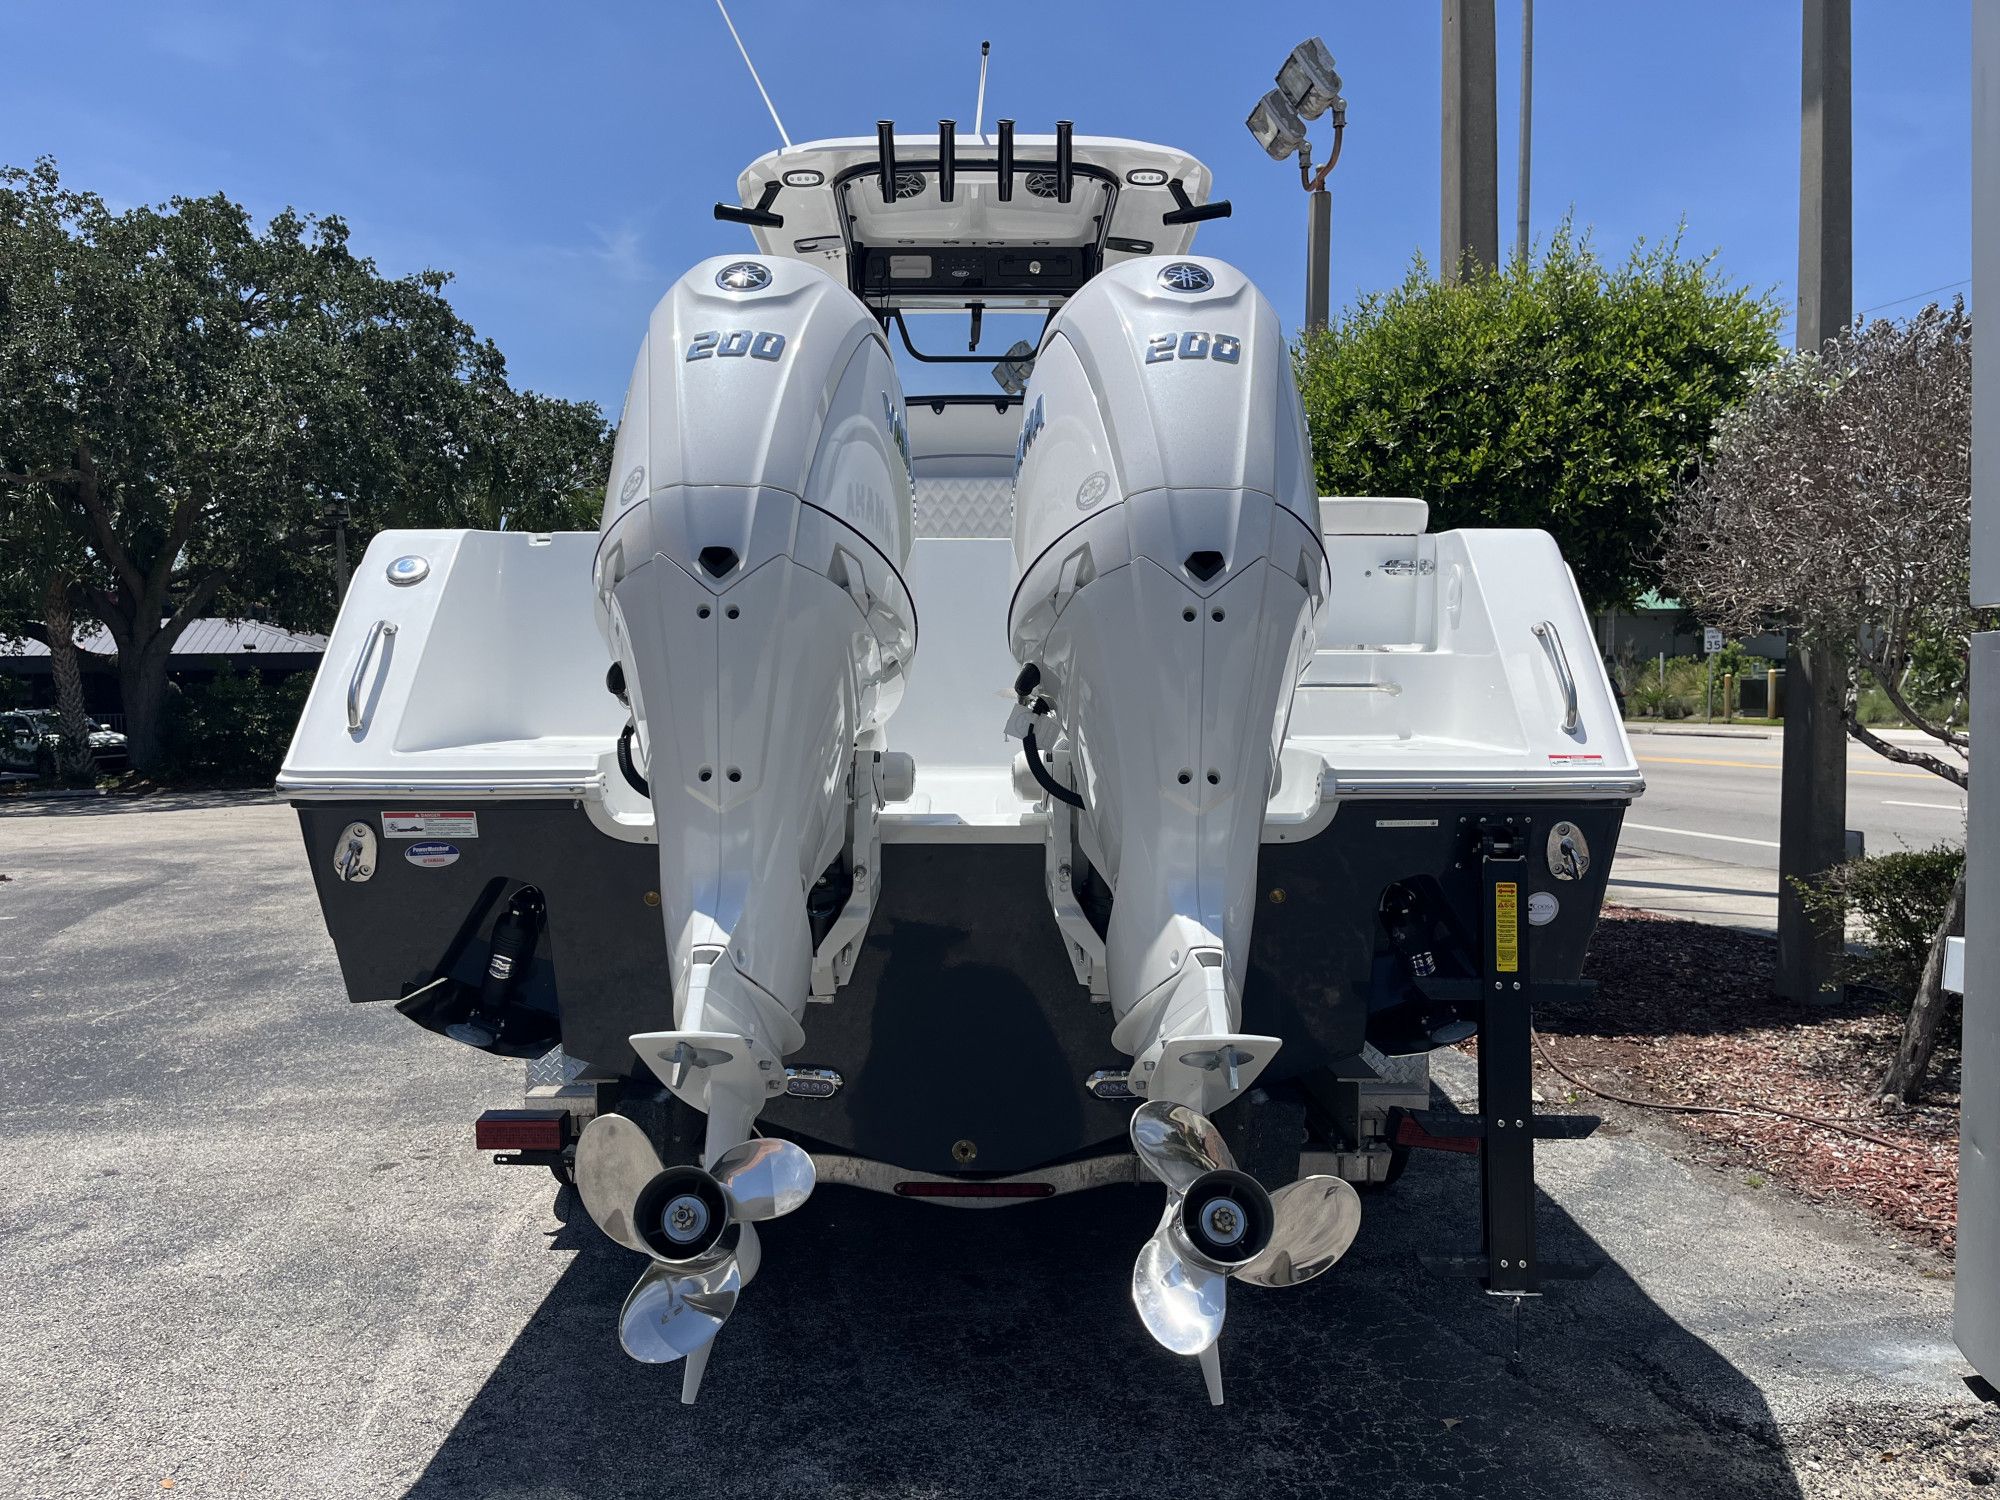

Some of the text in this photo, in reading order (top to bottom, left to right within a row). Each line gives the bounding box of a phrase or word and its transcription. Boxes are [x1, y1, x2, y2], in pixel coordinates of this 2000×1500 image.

[686, 330, 786, 362] 200
[1145, 331, 1241, 365] 200
[1706, 641, 1721, 650] 35
